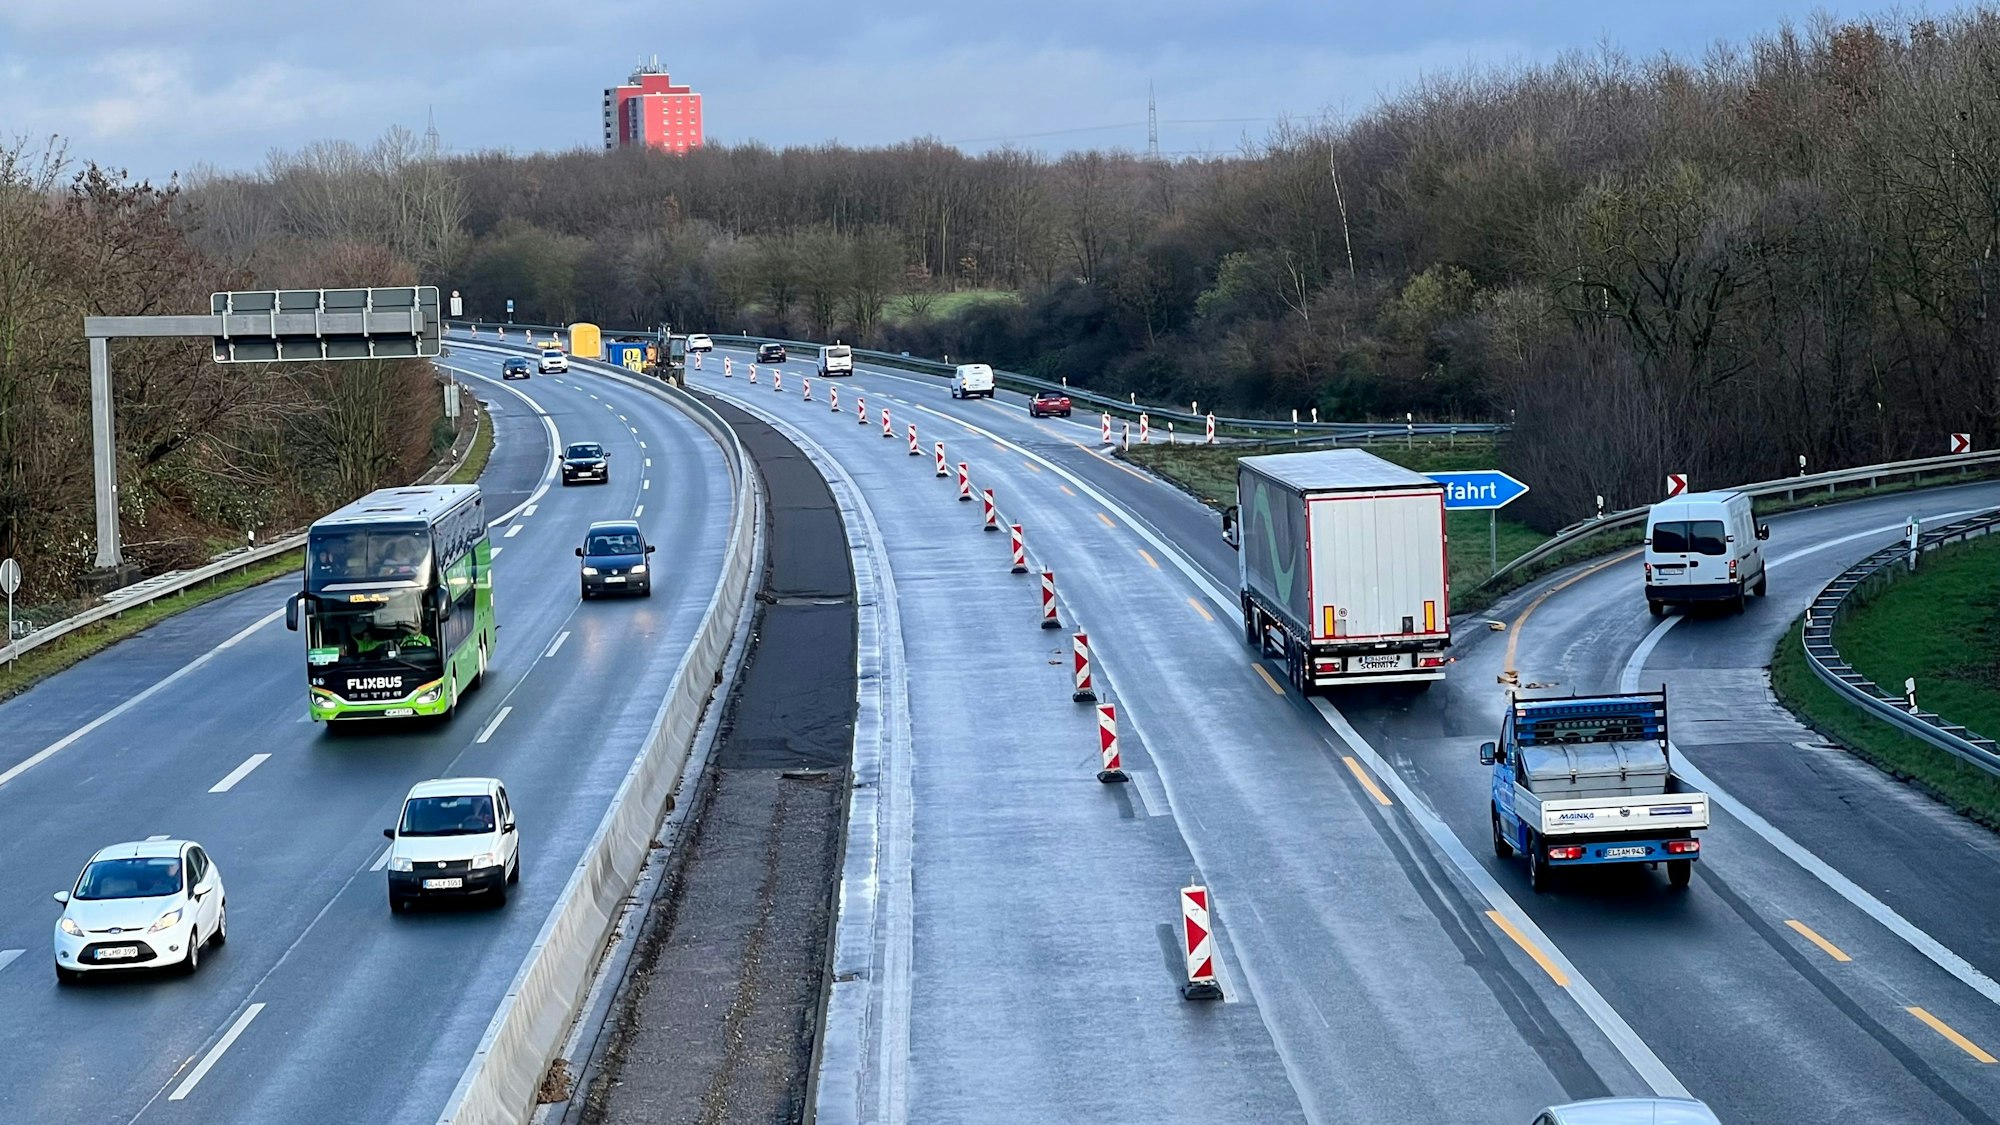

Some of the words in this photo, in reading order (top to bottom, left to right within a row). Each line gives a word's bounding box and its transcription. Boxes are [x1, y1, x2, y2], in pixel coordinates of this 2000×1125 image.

[1446, 481, 1497, 500] fahrt
[1360, 661, 1398, 669] SCHMITZ
[347, 676, 402, 690] FLIXBUS
[348, 690, 402, 699] SETRA
[1631, 847, 1645, 855] 943
